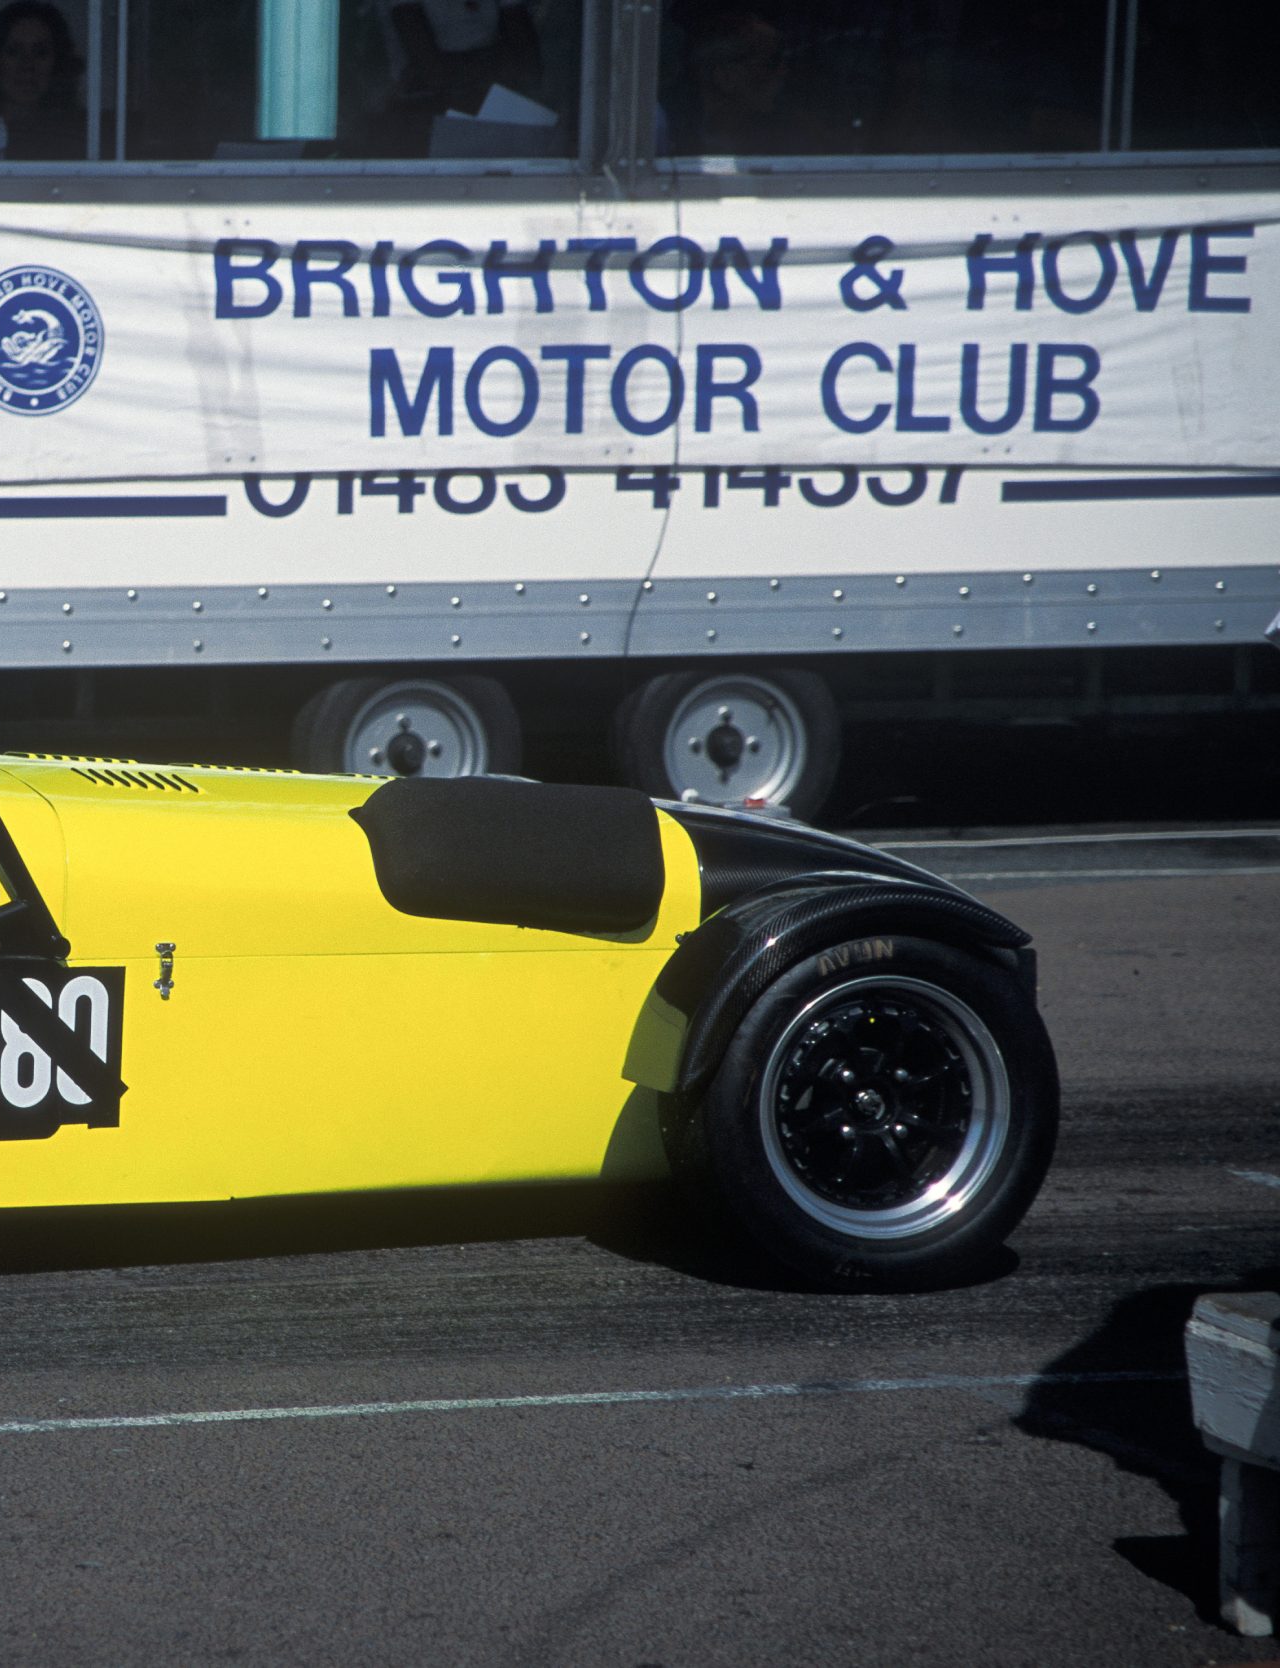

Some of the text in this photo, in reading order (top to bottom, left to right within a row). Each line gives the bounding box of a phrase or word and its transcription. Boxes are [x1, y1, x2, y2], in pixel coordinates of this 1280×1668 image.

[215, 224, 1255, 319] BRIGHTON & HOVE
[369, 342, 1100, 437] MOTOR CLUB
[818, 939, 893, 976] AVON
